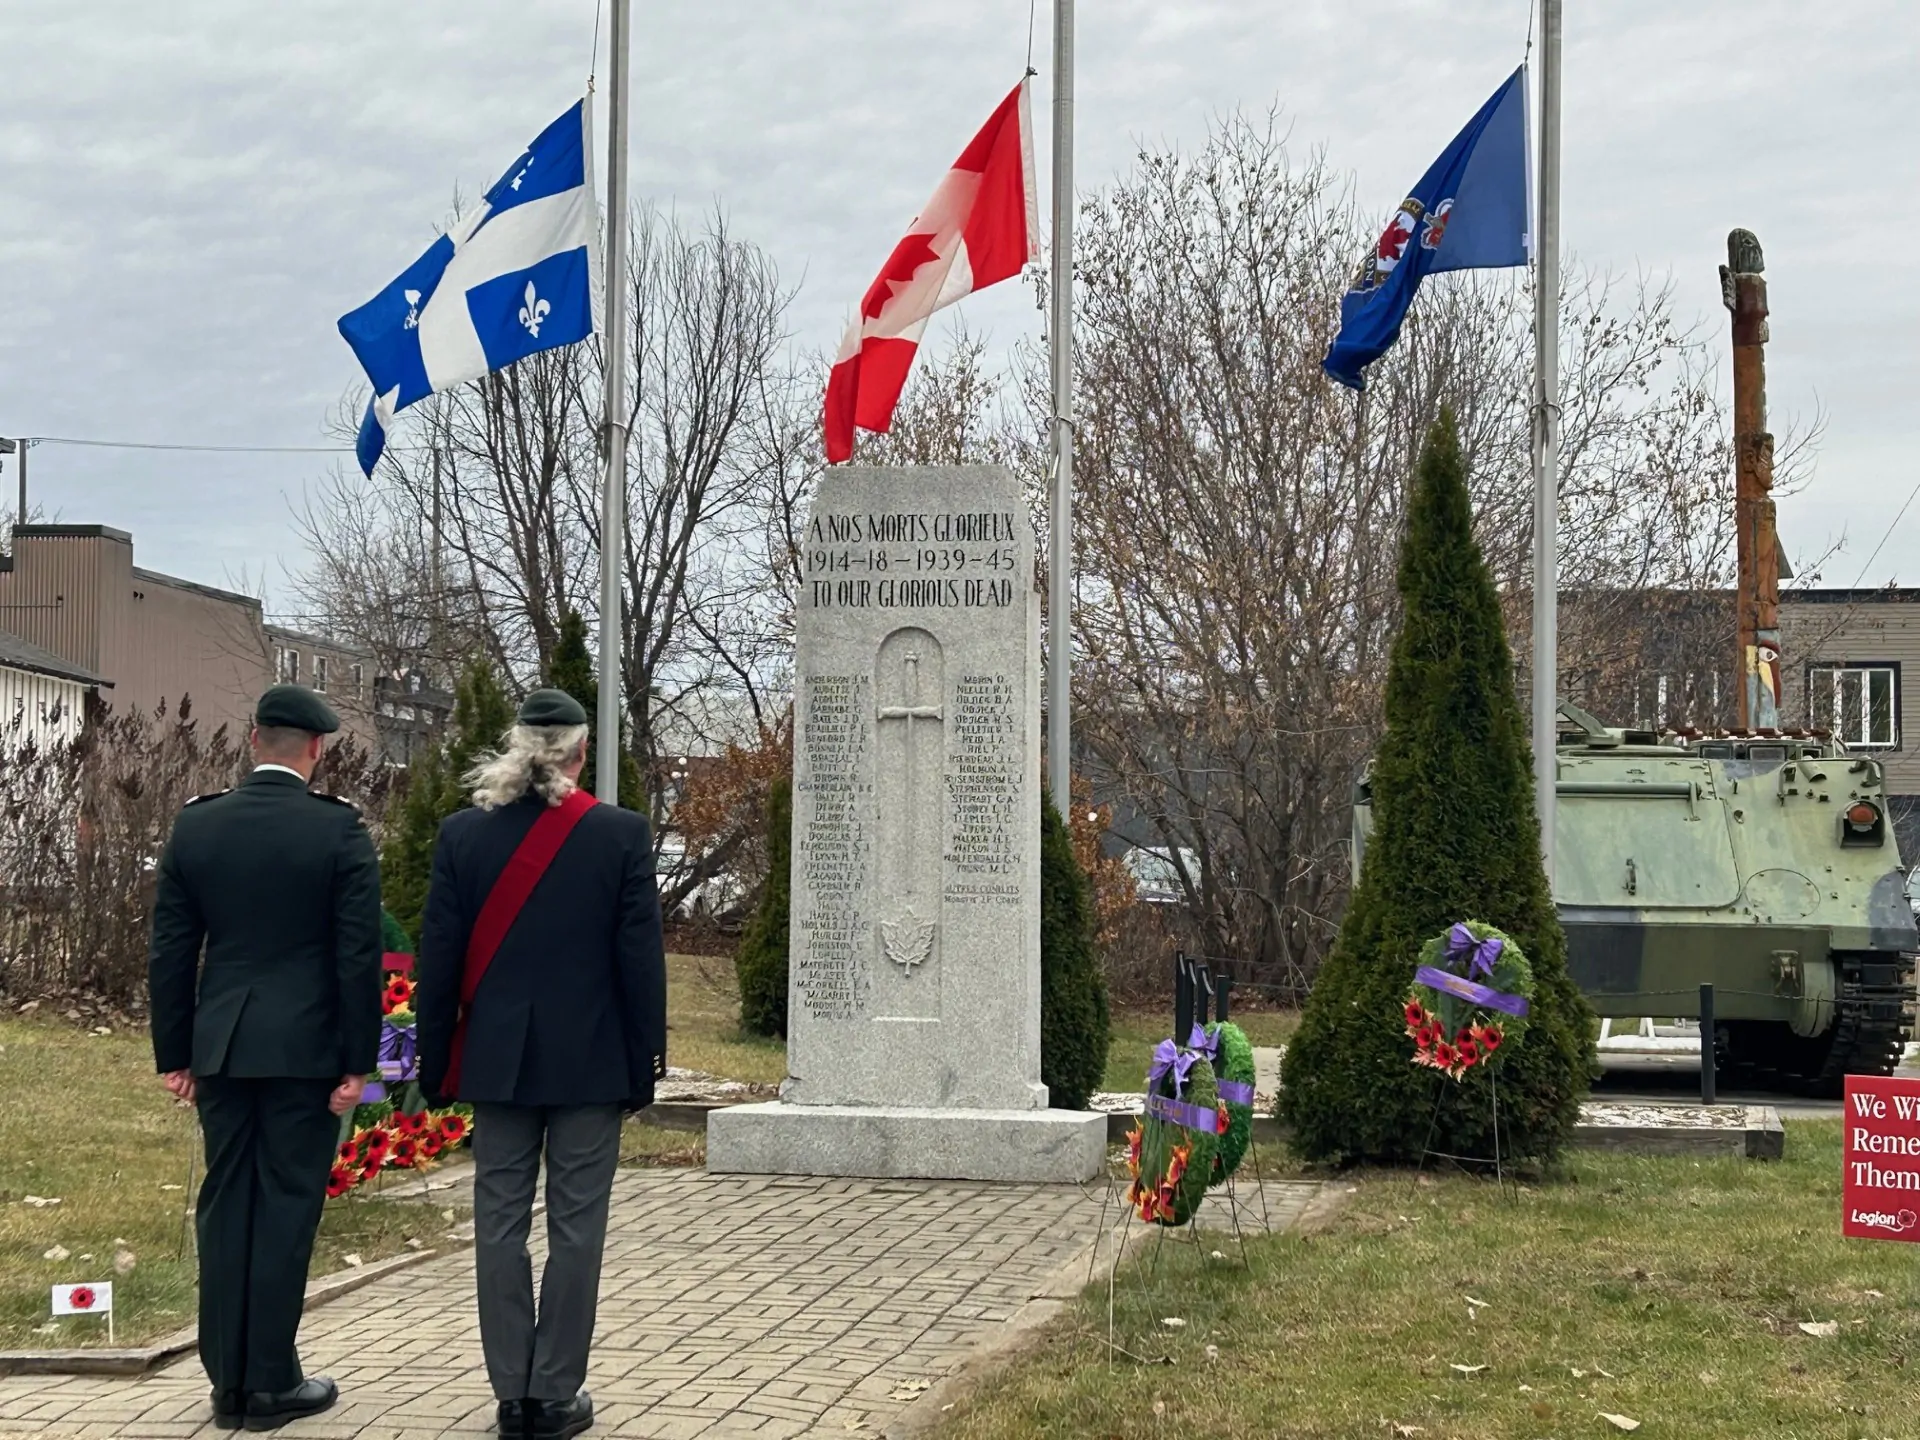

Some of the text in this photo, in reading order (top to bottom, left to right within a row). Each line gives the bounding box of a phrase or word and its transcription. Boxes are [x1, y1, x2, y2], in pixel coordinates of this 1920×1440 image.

[809, 513, 1015, 543] A NOS MORTS GLORIEUX
[808, 548, 888, 572] 1914-18
[916, 549, 1015, 571] 1939-45
[813, 578, 1012, 608] TO OUR GLORIOUS DEAD
[1852, 1093, 1886, 1119] We
[1851, 1161, 1920, 1190] Them
[1851, 1208, 1896, 1227] Legion
